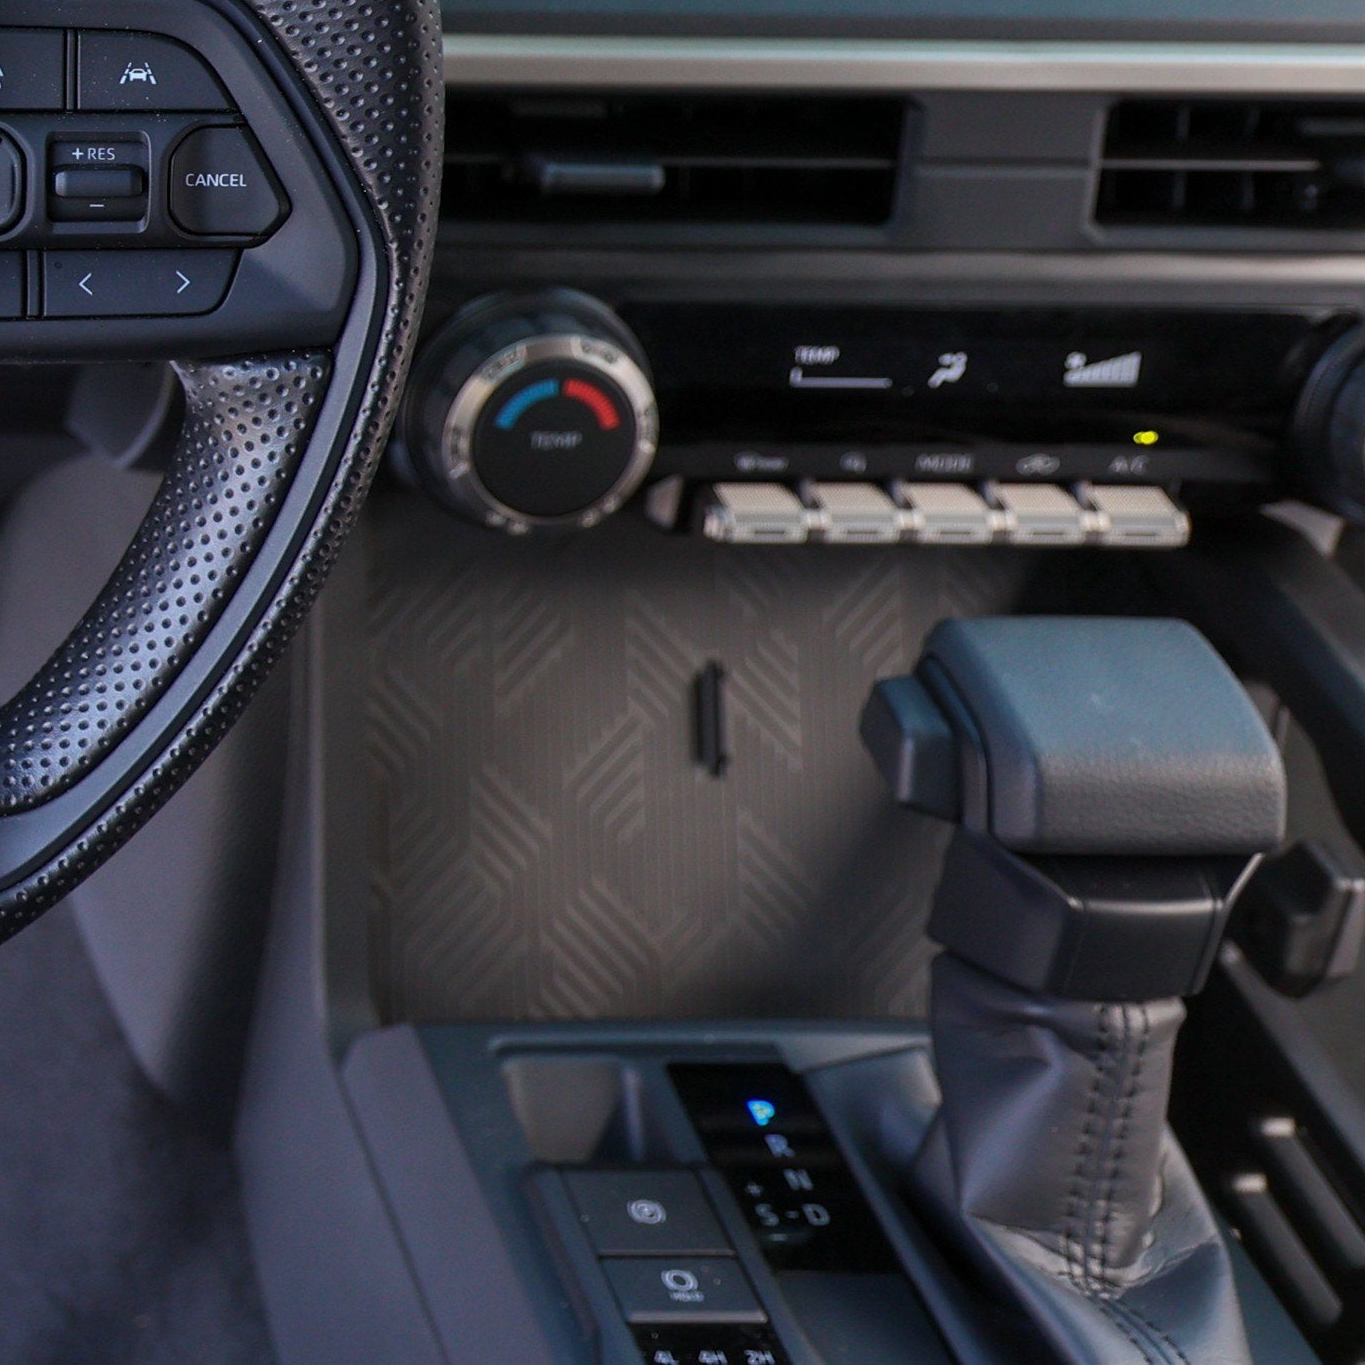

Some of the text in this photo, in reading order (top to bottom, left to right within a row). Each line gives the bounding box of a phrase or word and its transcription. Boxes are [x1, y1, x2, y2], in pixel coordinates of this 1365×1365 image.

[185, 172, 248, 188] CANCEL
[746, 1098, 776, 1126] P
[803, 1202, 831, 1227] D
